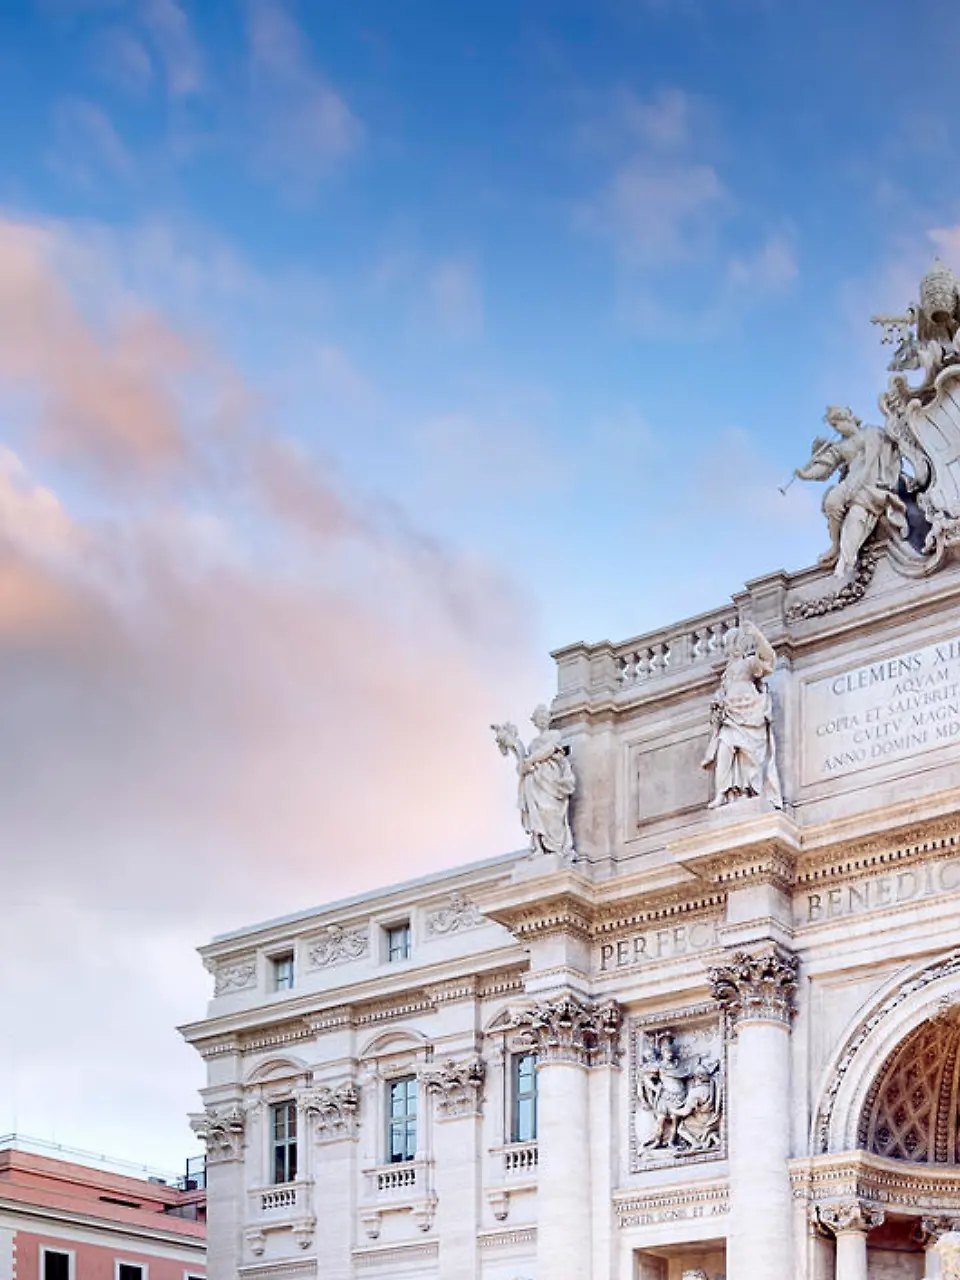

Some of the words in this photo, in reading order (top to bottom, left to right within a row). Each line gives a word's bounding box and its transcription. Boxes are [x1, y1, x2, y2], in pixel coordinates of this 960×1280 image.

[832, 653, 922, 695] CLEMENS
[893, 668, 948, 696] AQVAM
[816, 715, 858, 736] COPIA
[866, 707, 881, 722] ET
[853, 718, 903, 743] CVLTV
[822, 749, 866, 772] ANNO
[871, 730, 928, 758] DOMINI
